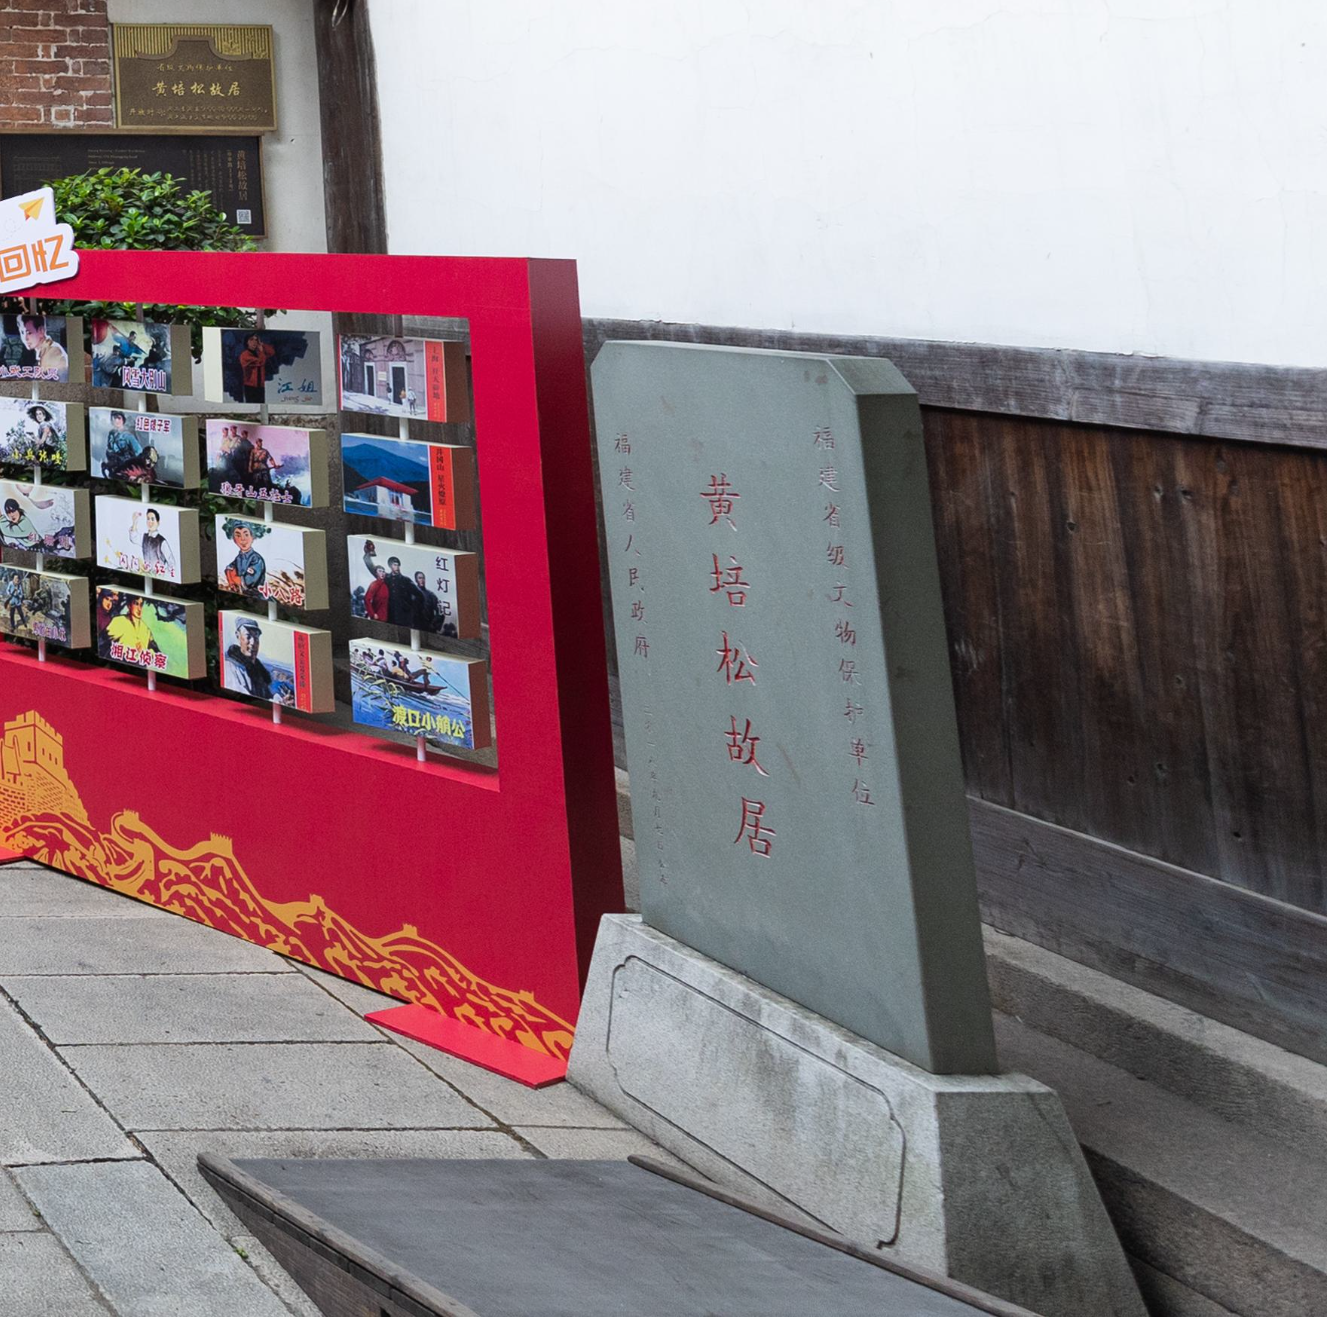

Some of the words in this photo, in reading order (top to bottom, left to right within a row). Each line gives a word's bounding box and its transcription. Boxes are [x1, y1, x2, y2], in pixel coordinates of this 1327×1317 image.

[151, 80, 241, 97] 黄培松故居
[277, 377, 318, 394] 江姐
[613, 432, 651, 659] 福建省人民政府
[259, 584, 306, 609] 小八路
[435, 555, 452, 617] 红灯记
[110, 641, 168, 670] 湘江侦察
[698, 472, 777, 859] 黄培松故居
[392, 705, 466, 739] 渡口小艄公
